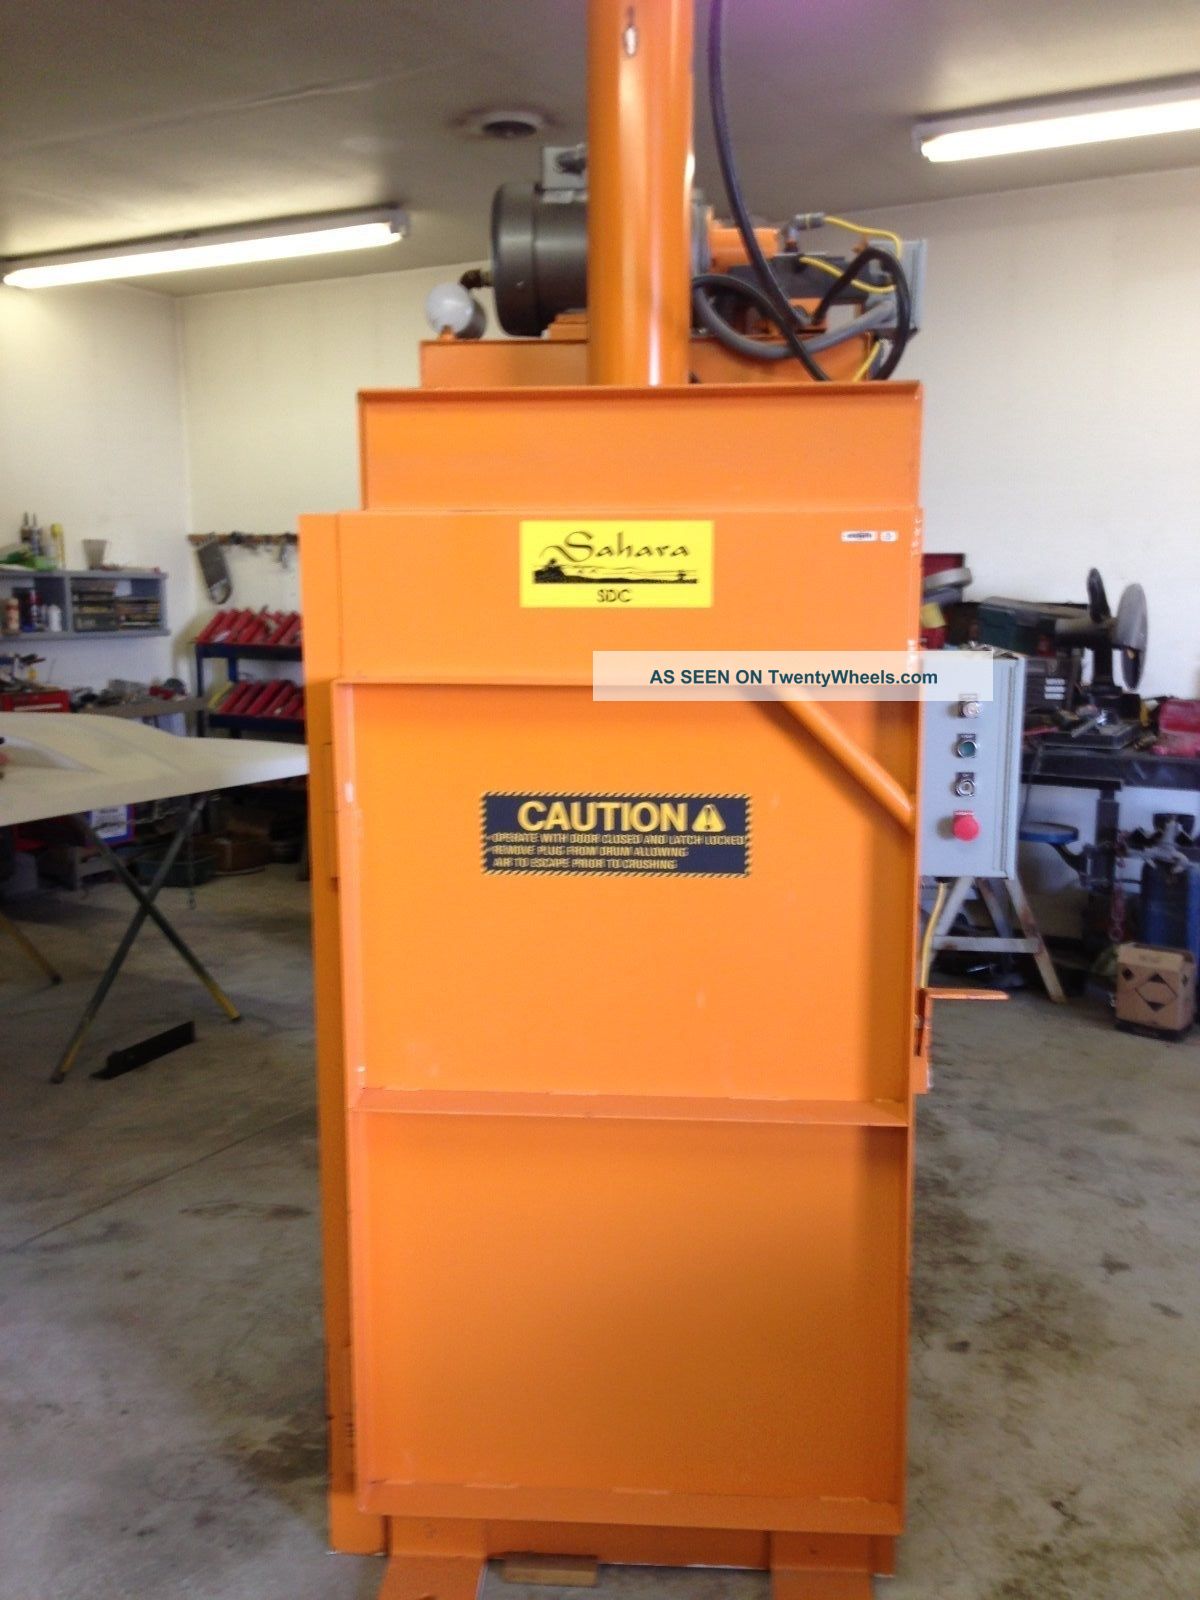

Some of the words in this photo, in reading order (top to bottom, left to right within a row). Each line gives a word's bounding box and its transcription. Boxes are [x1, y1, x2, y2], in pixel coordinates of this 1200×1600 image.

[539, 530, 689, 563] Sahara
[597, 588, 632, 603] SDC
[517, 800, 688, 832] CAUTION
[492, 832, 538, 843] OPERATE
[540, 833, 567, 843] WITH
[569, 833, 599, 844] DOOR
[601, 833, 642, 844] CLOSED
[643, 834, 667, 845] AND
[668, 834, 702, 845] LATCH
[704, 834, 745, 845] LOCKED
[492, 845, 535, 855] REMOVE
[536, 845, 565, 856] PLUG
[566, 846, 597, 856] FROM
[599, 846, 631, 856] DRUM
[633, 847, 688, 857] ALLOWING
[493, 858, 512, 867] AIR
[514, 858, 529, 868] TO
[530, 858, 569, 868] ESCAPE
[571, 858, 604, 869] PRIOR
[606, 859, 620, 869] TO
[622, 859, 677, 869] CRUSHING
